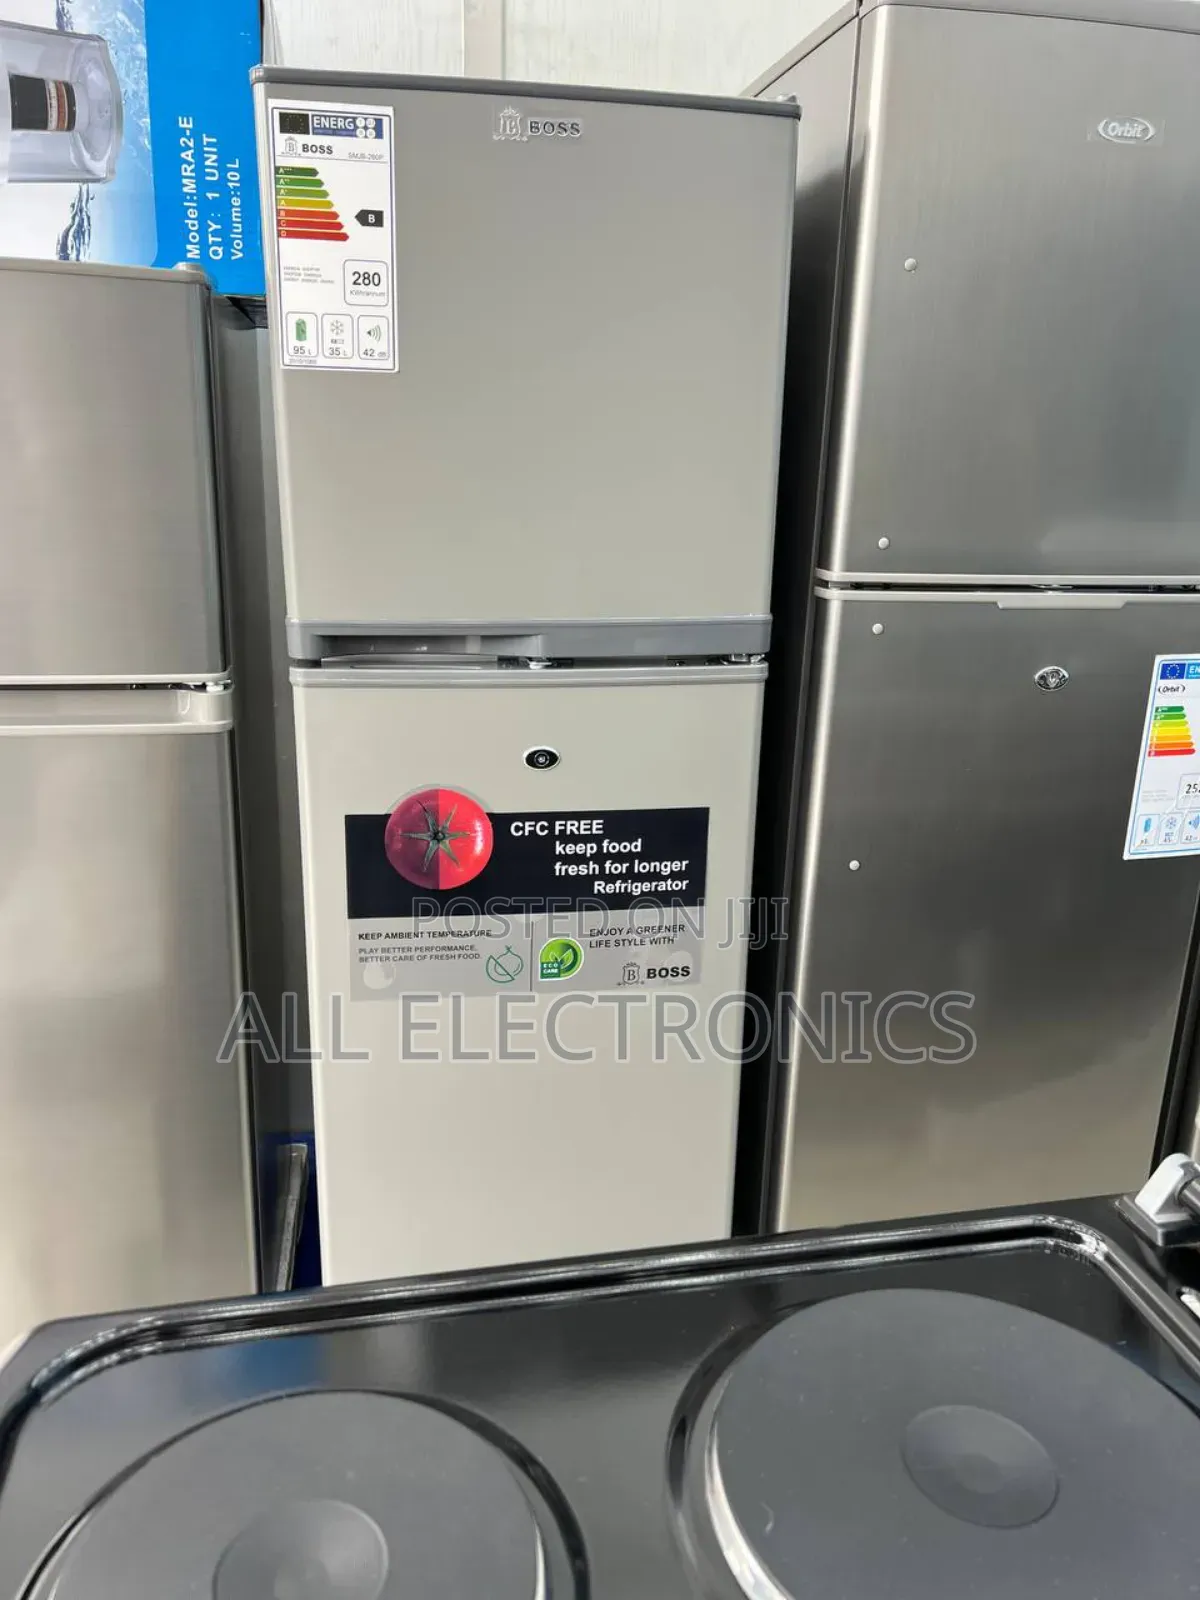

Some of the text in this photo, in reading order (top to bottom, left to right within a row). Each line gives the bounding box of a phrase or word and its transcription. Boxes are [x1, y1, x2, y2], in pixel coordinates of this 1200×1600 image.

[313, 116, 355, 130] ENERG
[529, 119, 581, 137] BOSS
[1107, 122, 1142, 137] Orbit
[302, 143, 334, 155] BOSS
[202, 133, 220, 181] UNIT
[178, 116, 201, 259] Model:MRA2-E
[205, 191, 221, 200] 1
[368, 214, 376, 223] B
[352, 270, 381, 287] 280
[293, 345, 306, 355] 95
[329, 347, 341, 356] 35
[363, 348, 375, 357] 42
[510, 819, 604, 837] CFC FREE
[555, 838, 642, 858] keep food
[554, 858, 689, 876] fresh for longer
[593, 877, 689, 896] Refrigerator
[358, 929, 492, 941] KEEP AMBIENT TEMPERATURE
[589, 927, 623, 937] ENJOY
[636, 924, 685, 935] GREENER
[589, 937, 675, 949] LIFE STYLE WITH
[358, 947, 378, 955] PLAY
[381, 946, 413, 954] BETTER
[359, 955, 391, 963] BETTER
[429, 953, 456, 961] FRESH
[646, 965, 691, 980] BOSS
